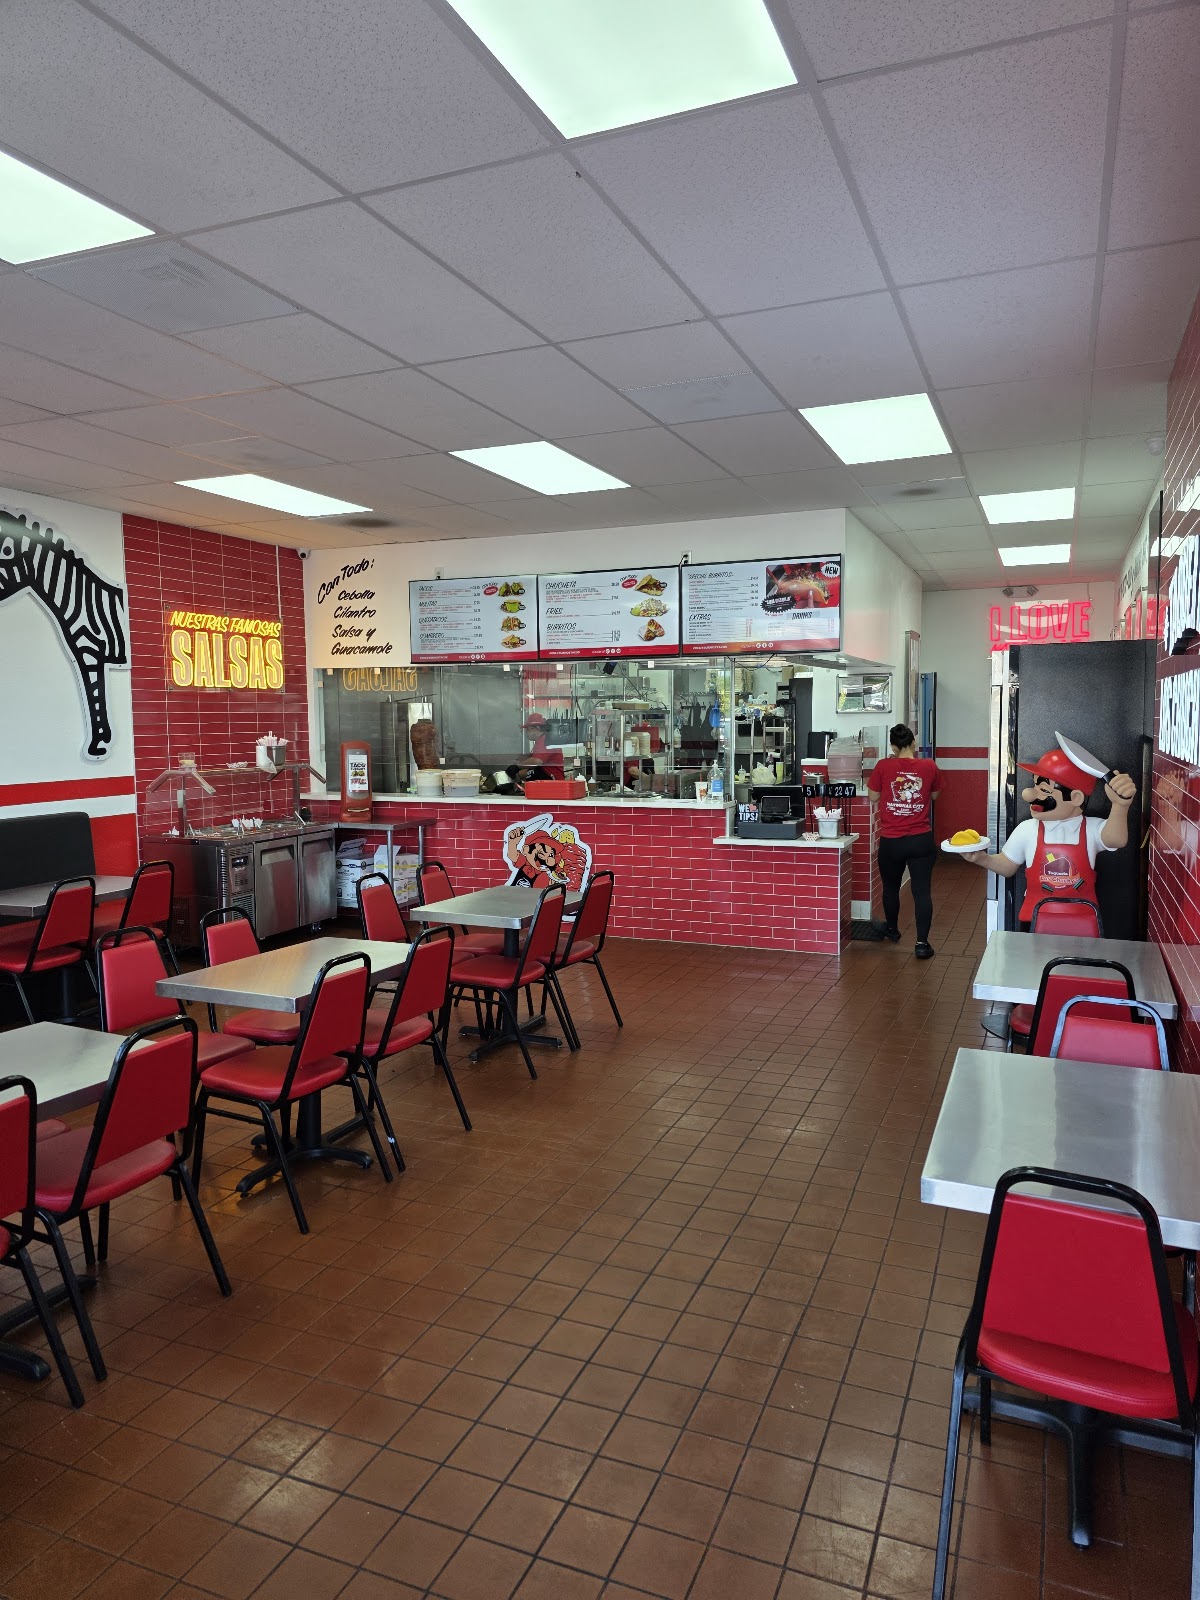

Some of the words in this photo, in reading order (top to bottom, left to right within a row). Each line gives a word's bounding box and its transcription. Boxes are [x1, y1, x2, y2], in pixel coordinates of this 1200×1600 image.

[825, 566, 839, 575] NEW
[318, 576, 340, 604] Con
[341, 558, 375, 580] Todo:
[338, 590, 375, 601] Cebolla
[333, 606, 376, 618] Cilantro
[792, 612, 812, 620] DRINKS
[170, 611, 229, 633] NUESTRAS
[230, 617, 281, 638] FAMOSAS
[546, 623, 577, 631] BURRITOS
[990, 606, 1000, 642] I
[1009, 602, 1091, 641] LOVE
[332, 624, 363, 638] Salsa
[365, 628, 376, 642] y
[331, 642, 393, 655] Guacamole
[171, 629, 284, 689] SALSAS
[806, 786, 812, 796] 5
[834, 786, 843, 796] 22
[844, 786, 854, 796] 47
[738, 803, 750, 813] WE
[738, 812, 759, 821] TIPS!
